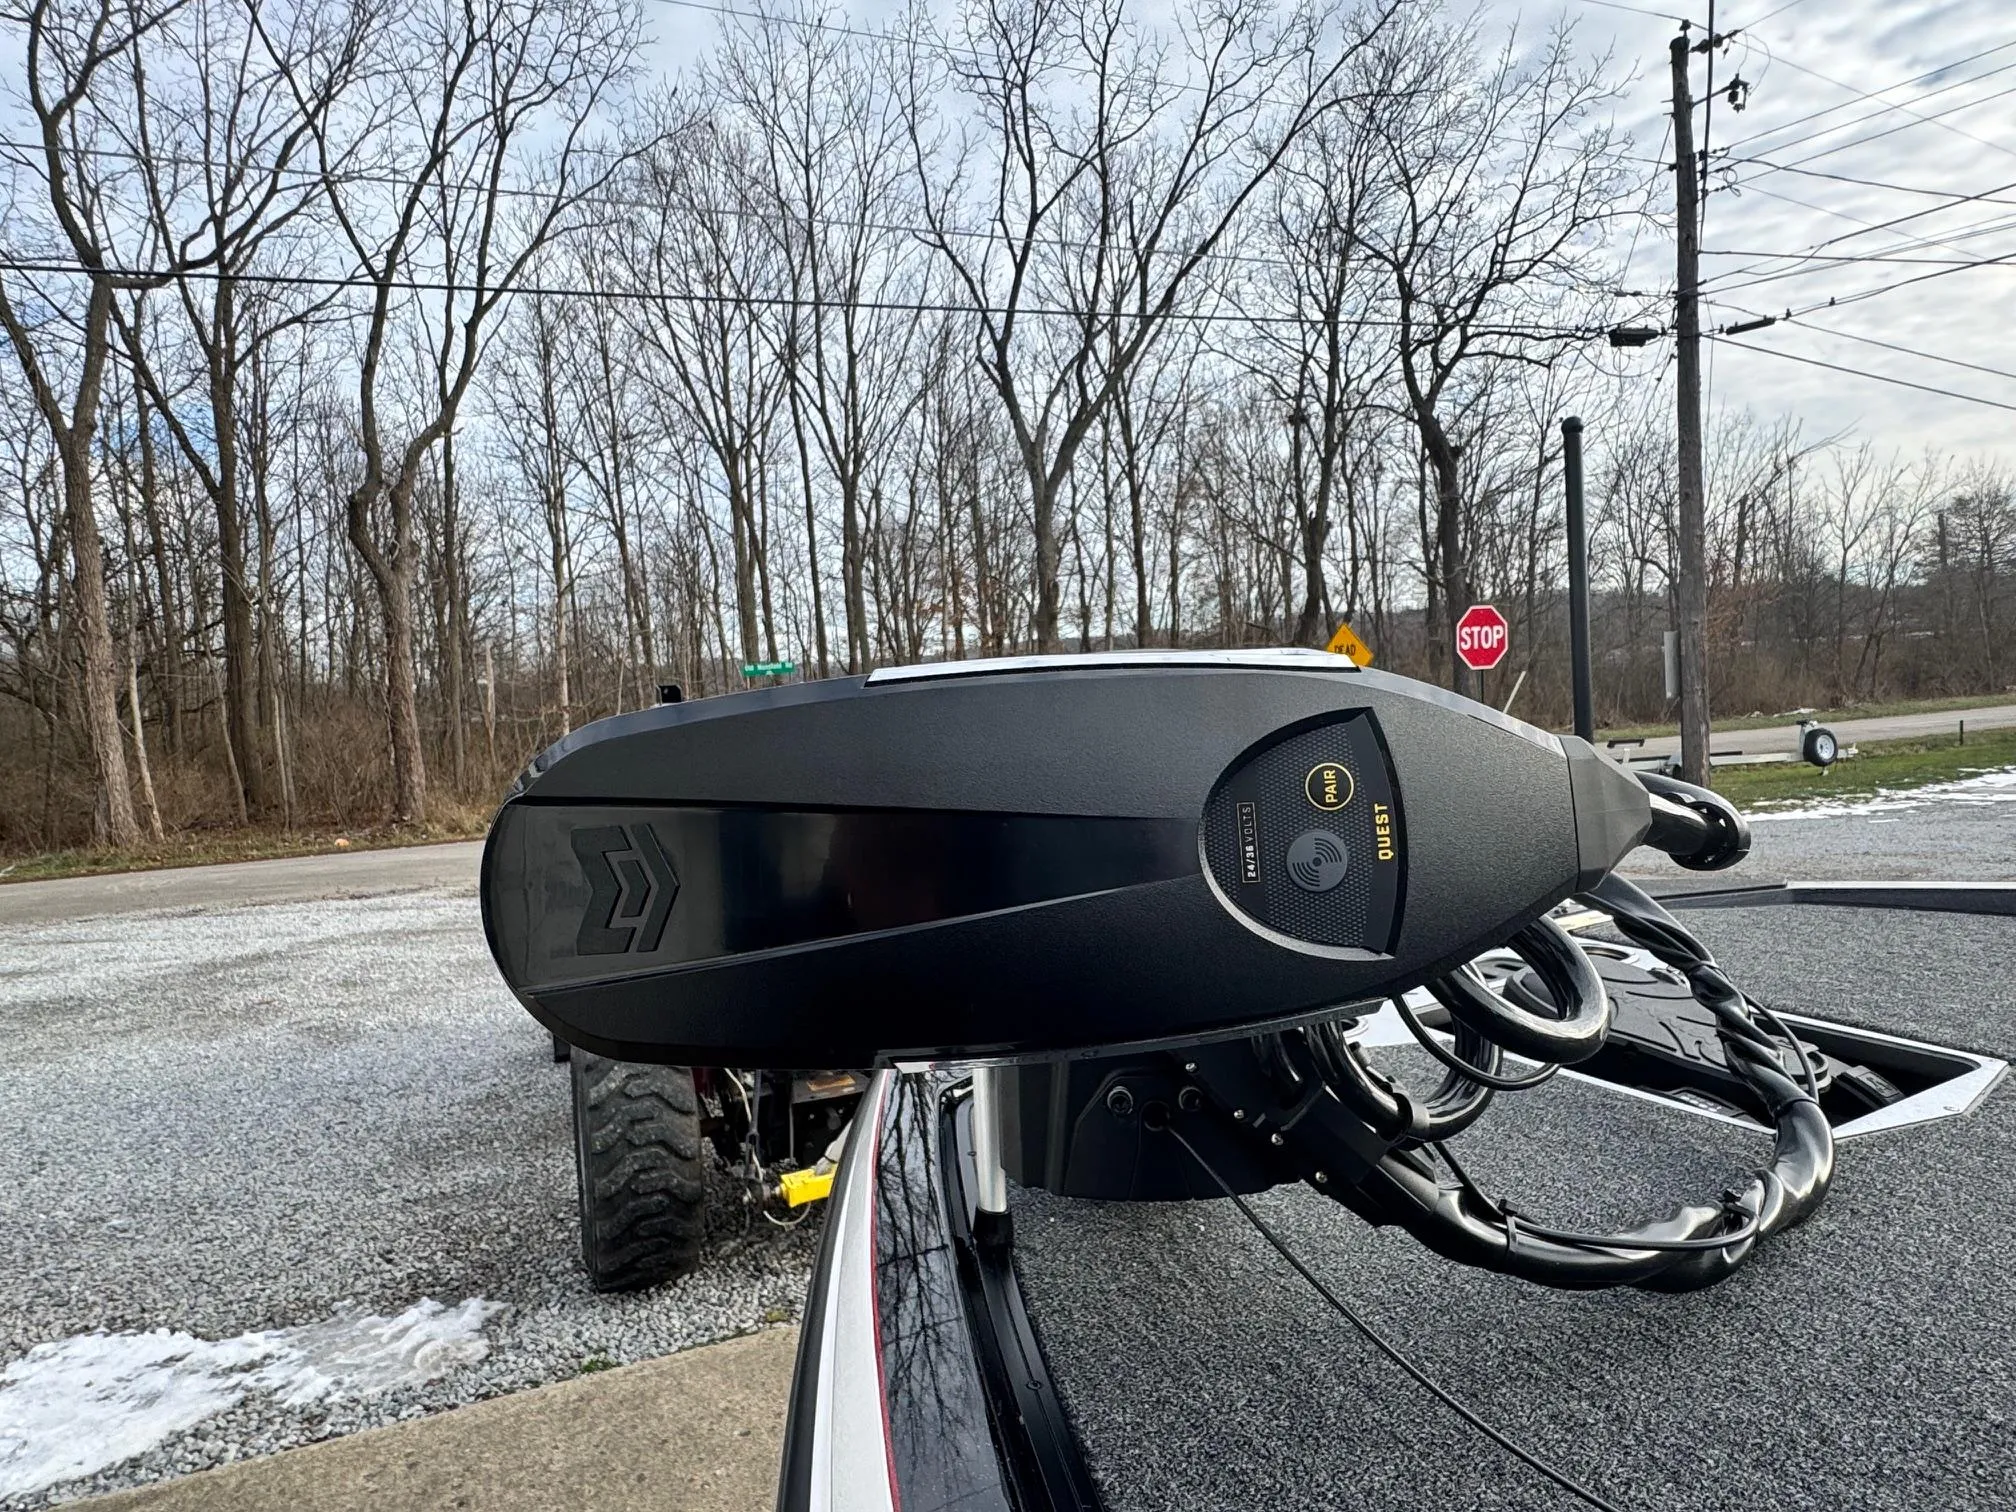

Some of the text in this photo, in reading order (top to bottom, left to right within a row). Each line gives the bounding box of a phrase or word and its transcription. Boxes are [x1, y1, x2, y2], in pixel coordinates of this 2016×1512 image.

[1460, 625, 1504, 651] STOP
[1323, 769, 1338, 803] PAIR
[1242, 806, 1256, 878] 24/36 VOLTS
[1374, 803, 1394, 861] QUEST
